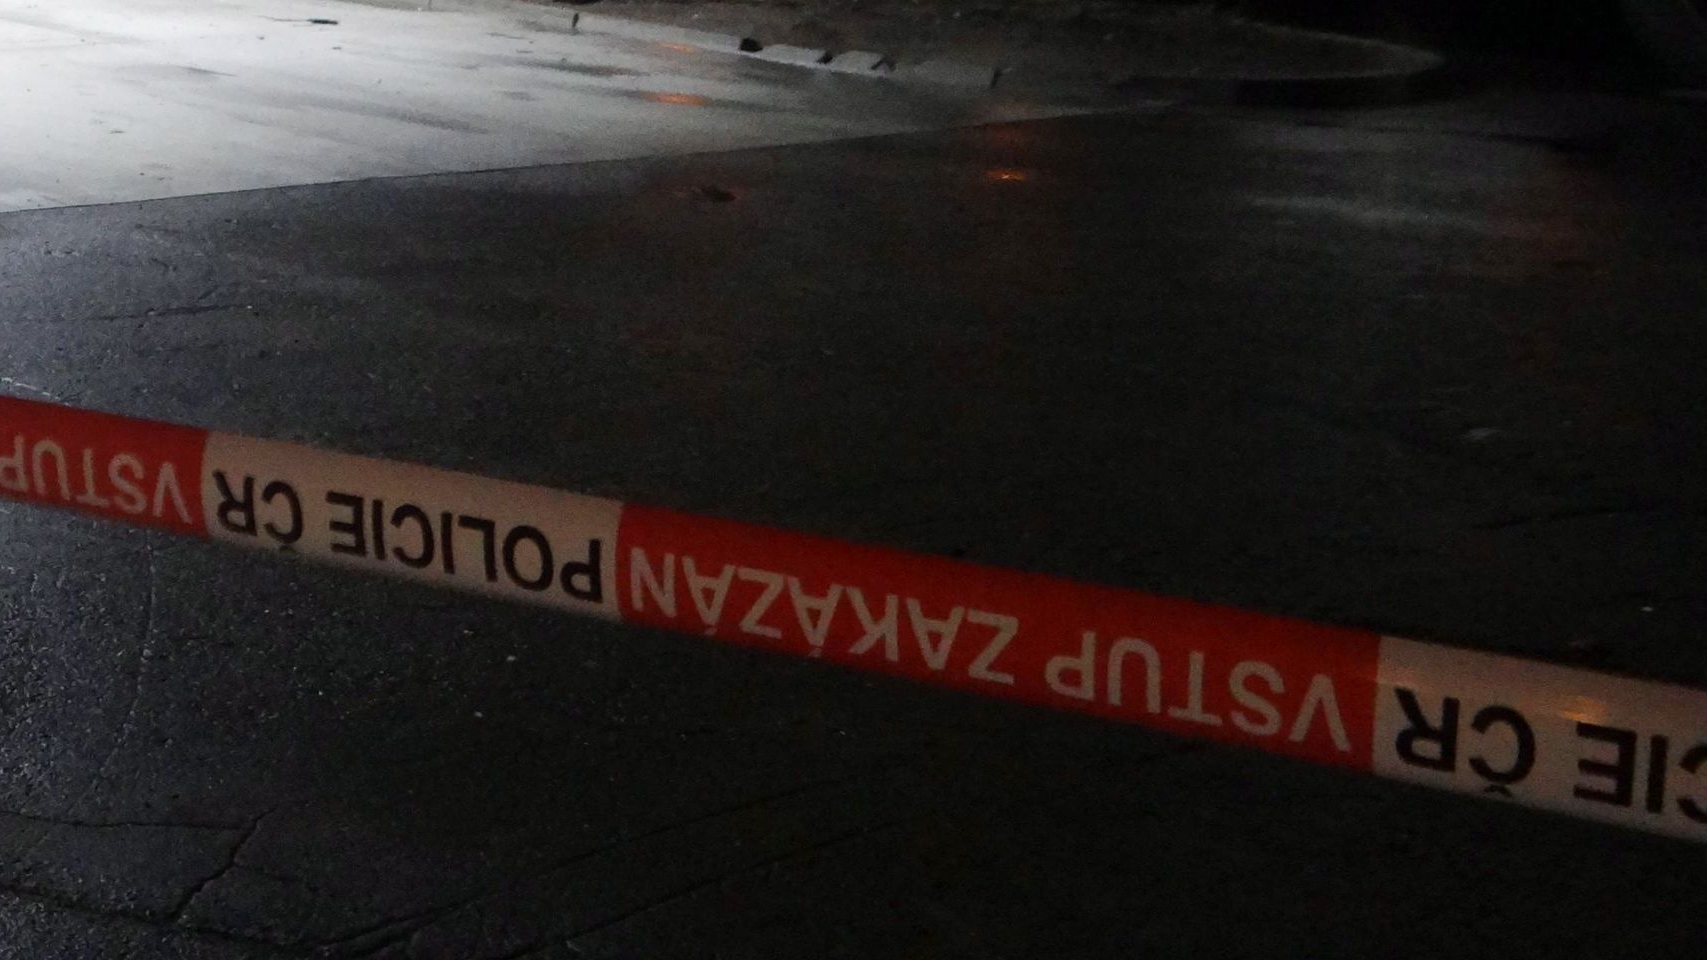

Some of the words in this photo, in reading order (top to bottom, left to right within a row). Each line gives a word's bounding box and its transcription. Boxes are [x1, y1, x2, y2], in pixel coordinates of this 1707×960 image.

[326, 490, 603, 603] POLICIE
[630, 547, 1021, 686] ZAKÁZÁN
[1044, 632, 1352, 753] VSTUP
[1393, 686, 1537, 798] ČR
